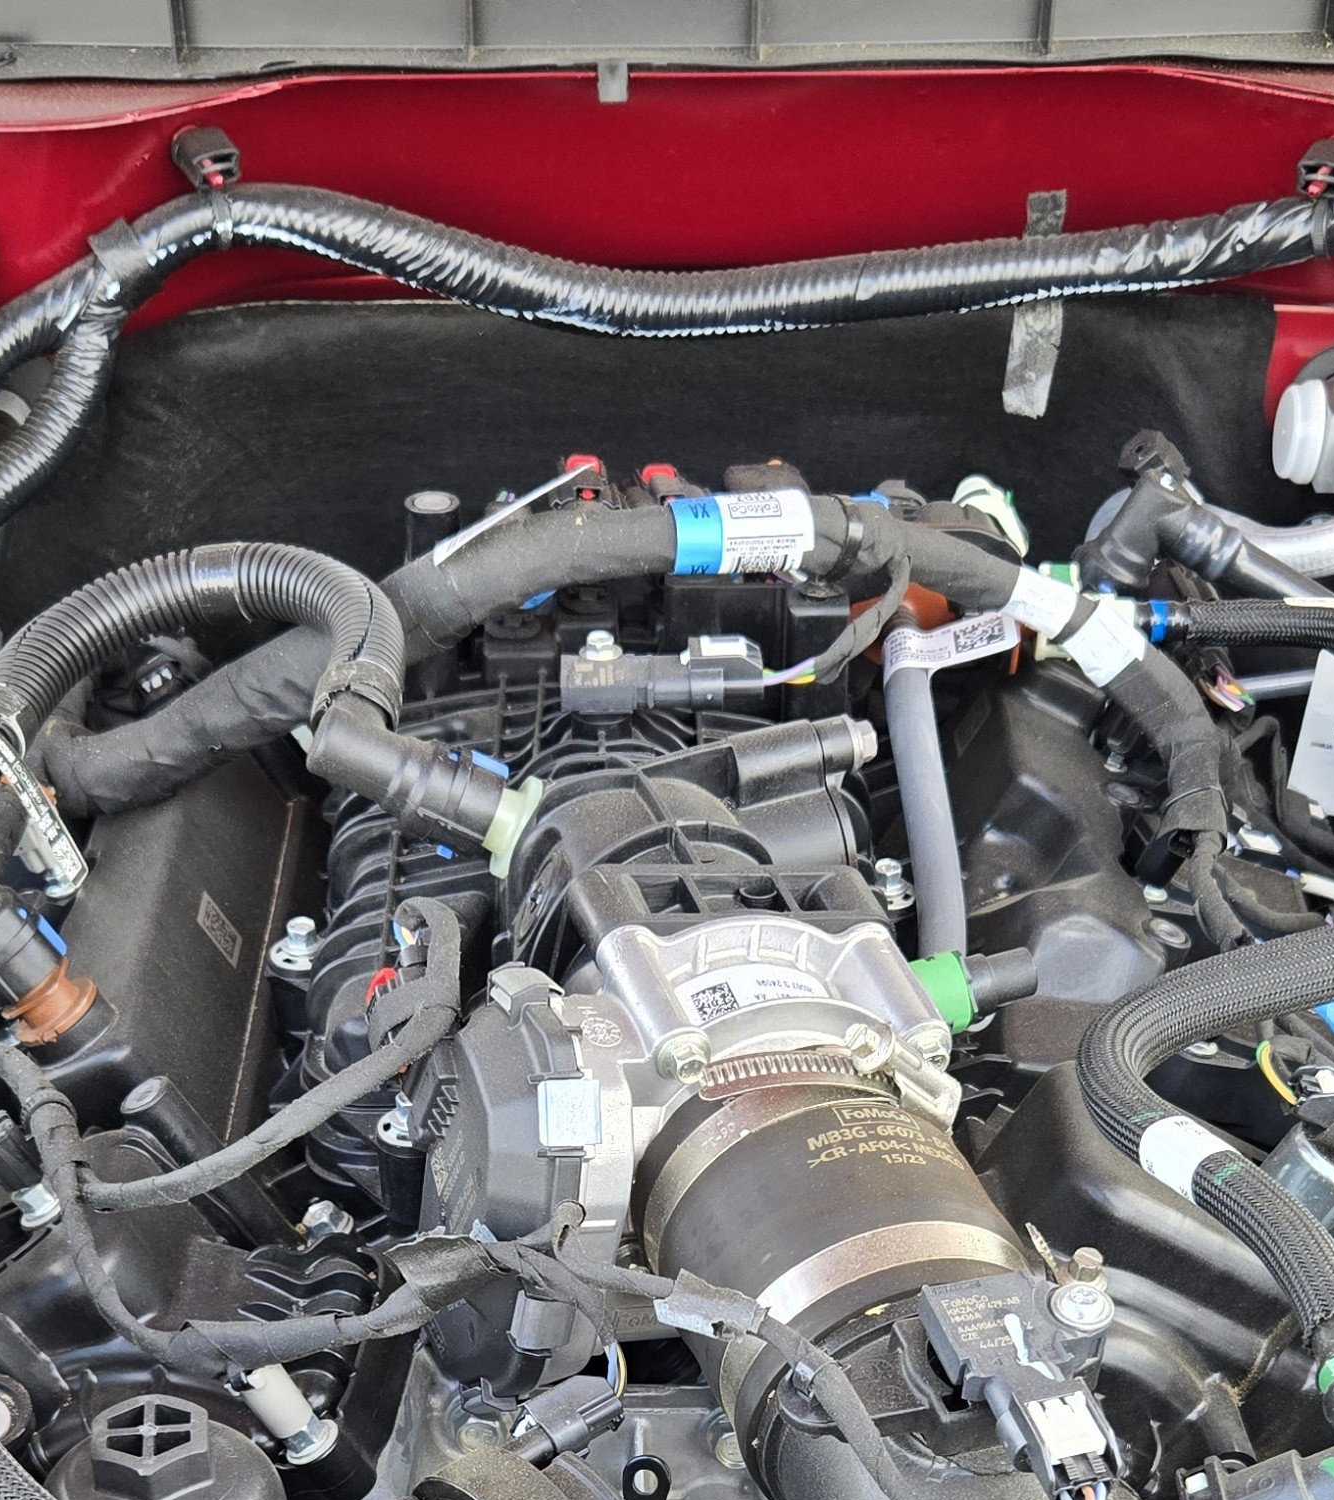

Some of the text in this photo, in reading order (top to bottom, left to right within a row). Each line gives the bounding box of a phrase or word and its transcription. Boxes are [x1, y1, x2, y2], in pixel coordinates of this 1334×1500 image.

[731, 503, 780, 516] FoMoCo
[841, 1108, 911, 1124] FoMoCo
[881, 1153, 927, 1166] 15/23
[941, 1294, 989, 1309] FoMoCo
